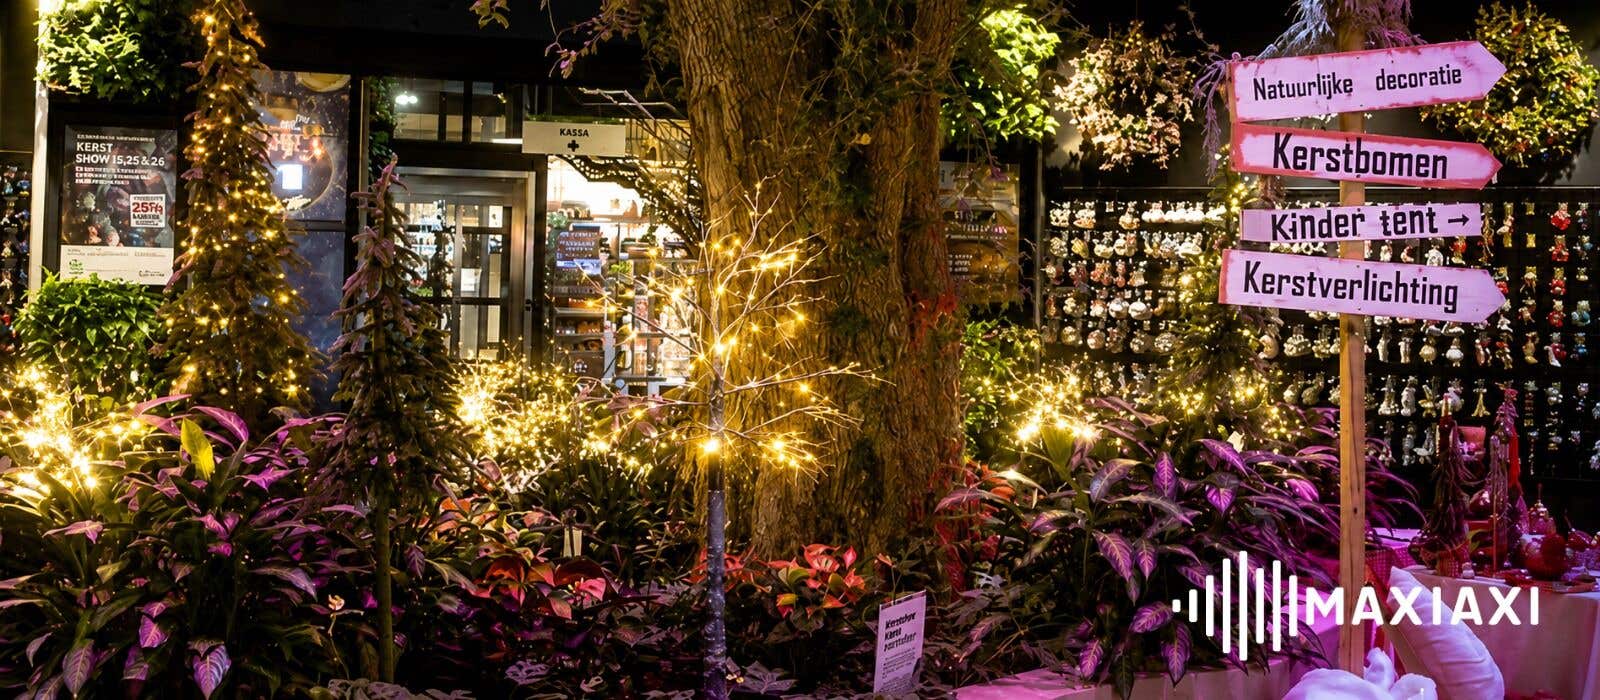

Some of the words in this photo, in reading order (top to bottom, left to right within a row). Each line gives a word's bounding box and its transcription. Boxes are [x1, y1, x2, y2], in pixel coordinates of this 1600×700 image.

[1253, 72, 1353, 101] Natuurlijke
[1375, 64, 1462, 91] decoratie
[76, 142, 113, 153] KERST
[559, 128, 589, 137] KASSA
[75, 154, 110, 164] SHOW
[141, 156, 150, 166] &
[151, 157, 165, 166] 26
[1273, 132, 1448, 179] Kerstbomen
[1271, 208, 1365, 241] Kinder
[1379, 207, 1439, 237] tent
[1243, 260, 1458, 314] Kerstverlichting
